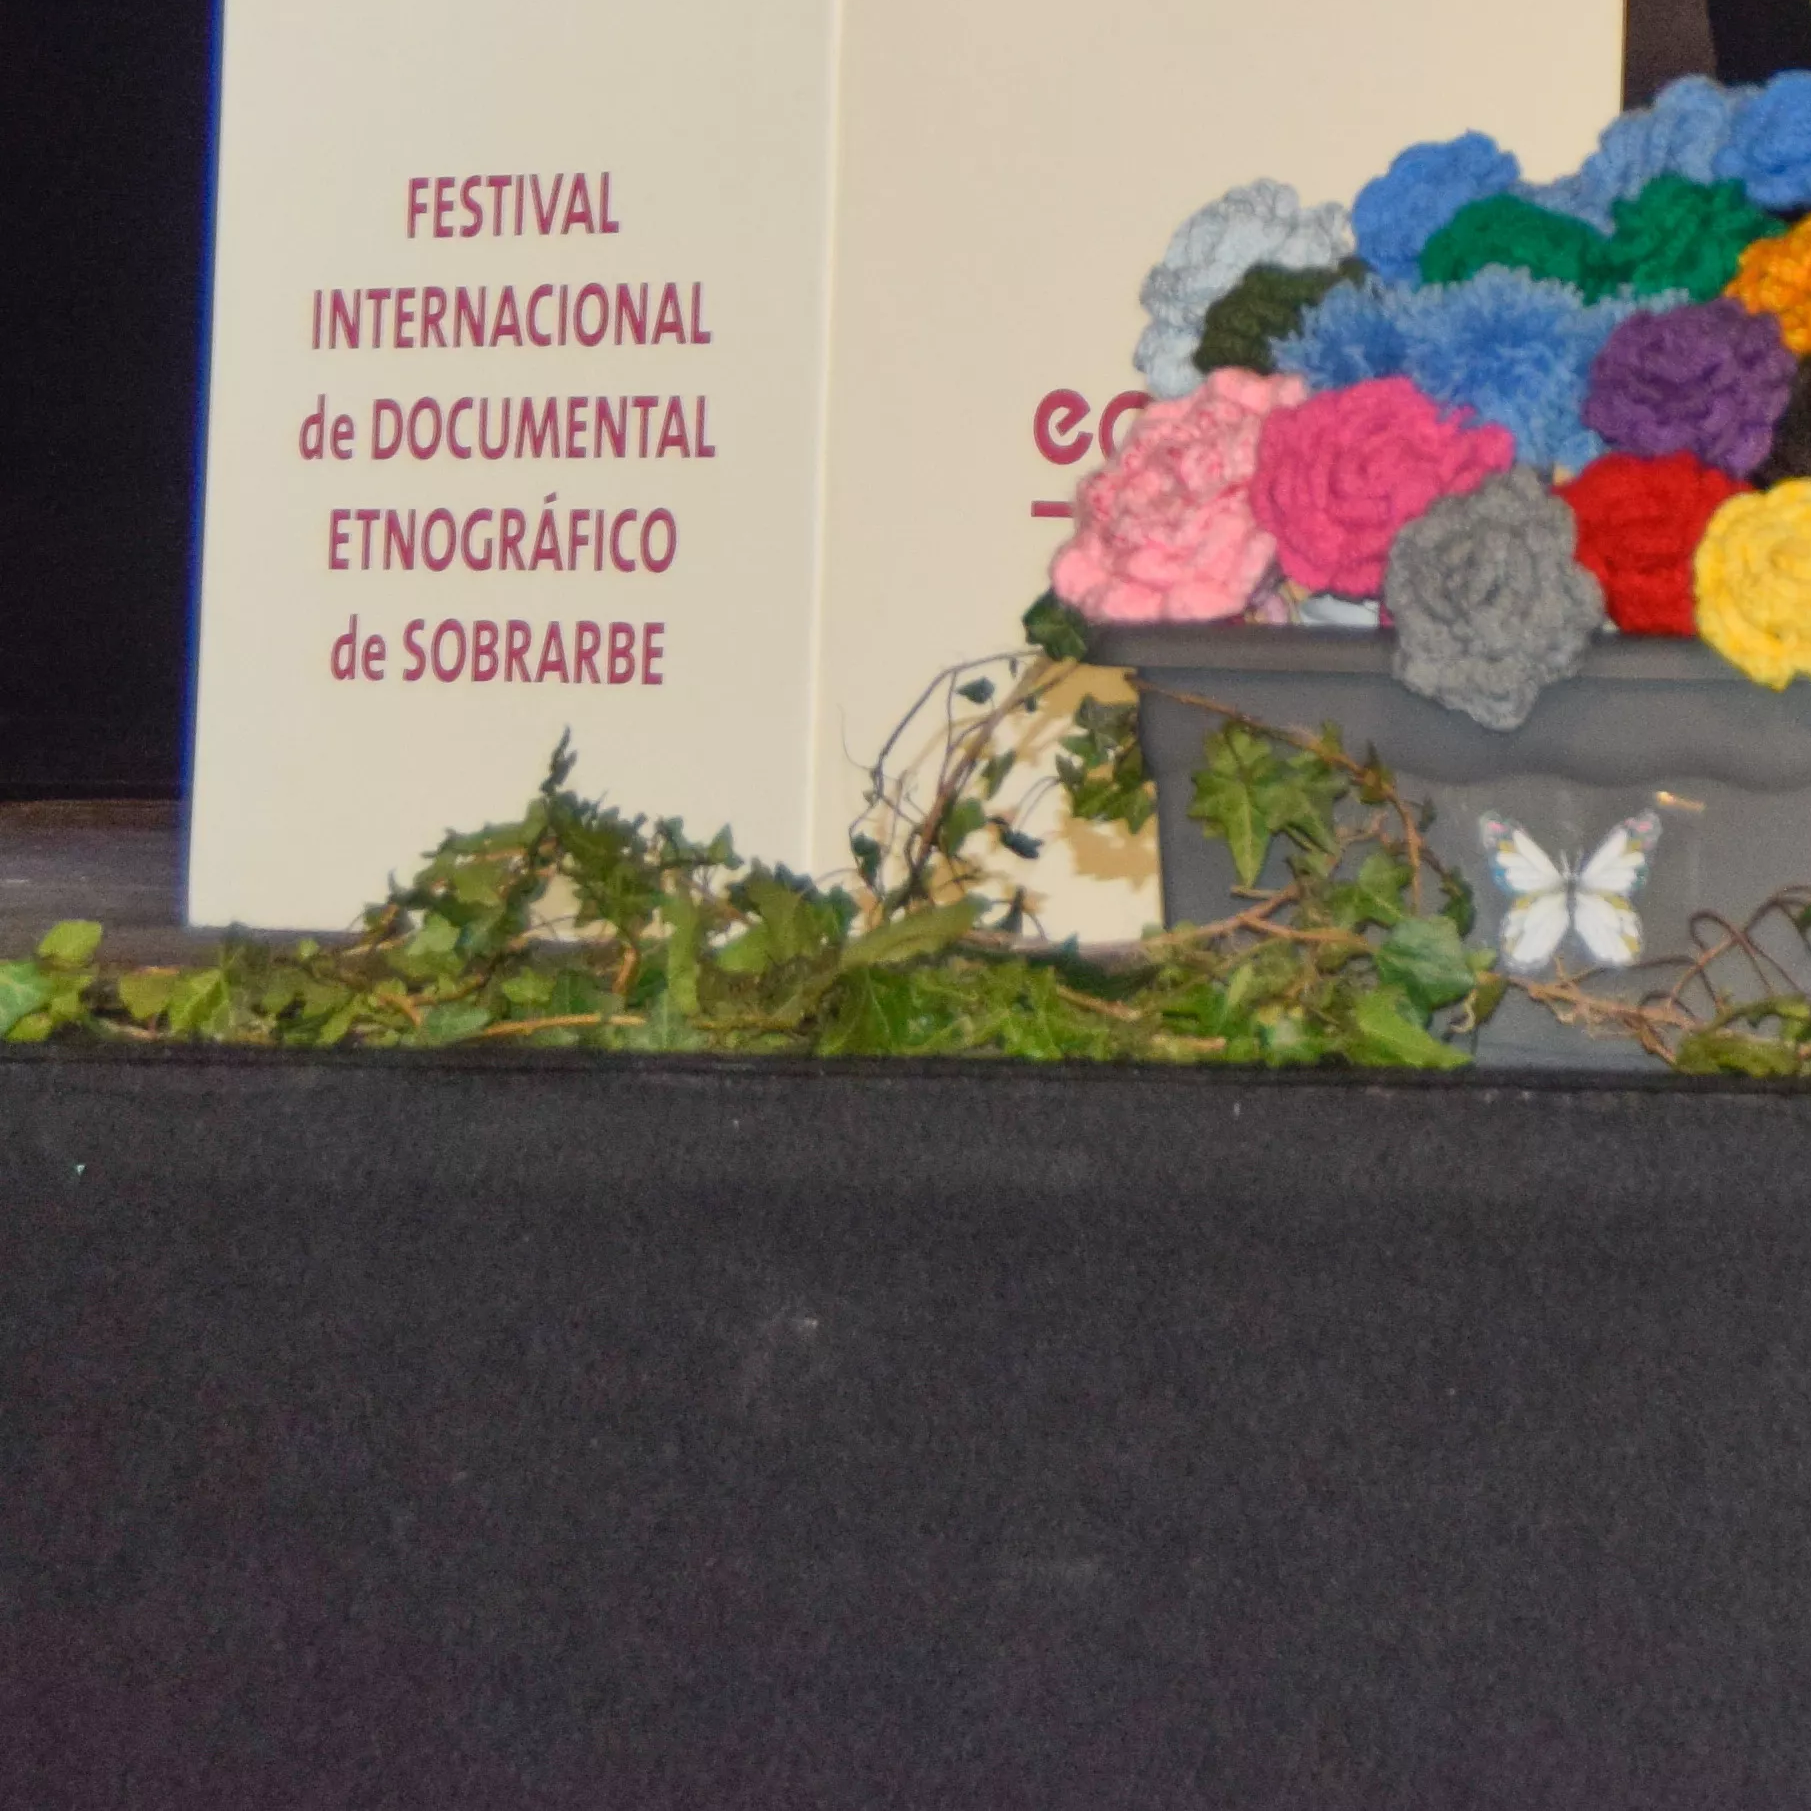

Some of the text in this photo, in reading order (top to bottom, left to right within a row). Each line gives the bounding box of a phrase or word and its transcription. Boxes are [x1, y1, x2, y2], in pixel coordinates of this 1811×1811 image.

[406, 172, 620, 237] FESTIVAL
[311, 282, 712, 350] INTERNACIONAL
[299, 393, 716, 461] de DOCUMENTAL
[327, 492, 678, 574] ETNOGRÁFICO
[330, 613, 665, 686] de SOBRARBE
